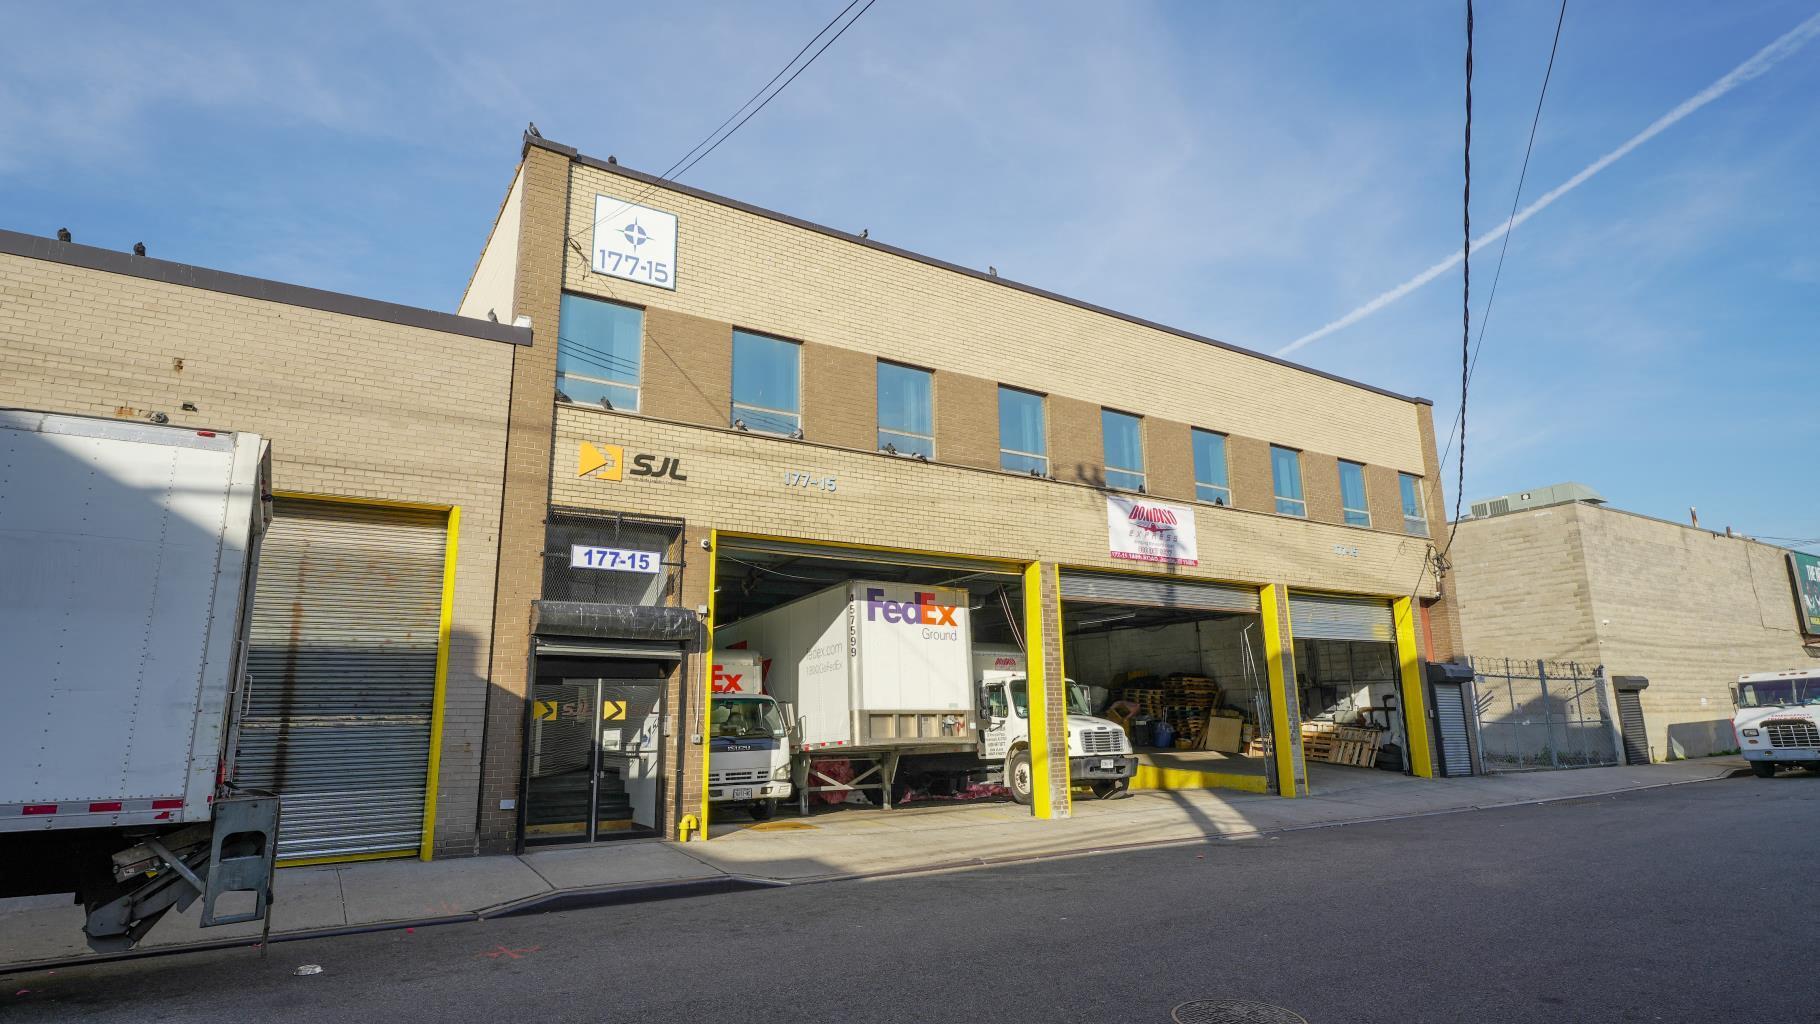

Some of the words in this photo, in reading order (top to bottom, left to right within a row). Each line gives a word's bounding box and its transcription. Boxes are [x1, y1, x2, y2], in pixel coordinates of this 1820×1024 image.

[599, 249, 669, 284] 177-15
[629, 454, 688, 482] SJL
[784, 471, 837, 492] 177-15
[583, 549, 651, 571] 177-15
[866, 587, 958, 627] FedEx
[921, 628, 957, 642] Ground
[727, 744, 751, 752] ISUZU
